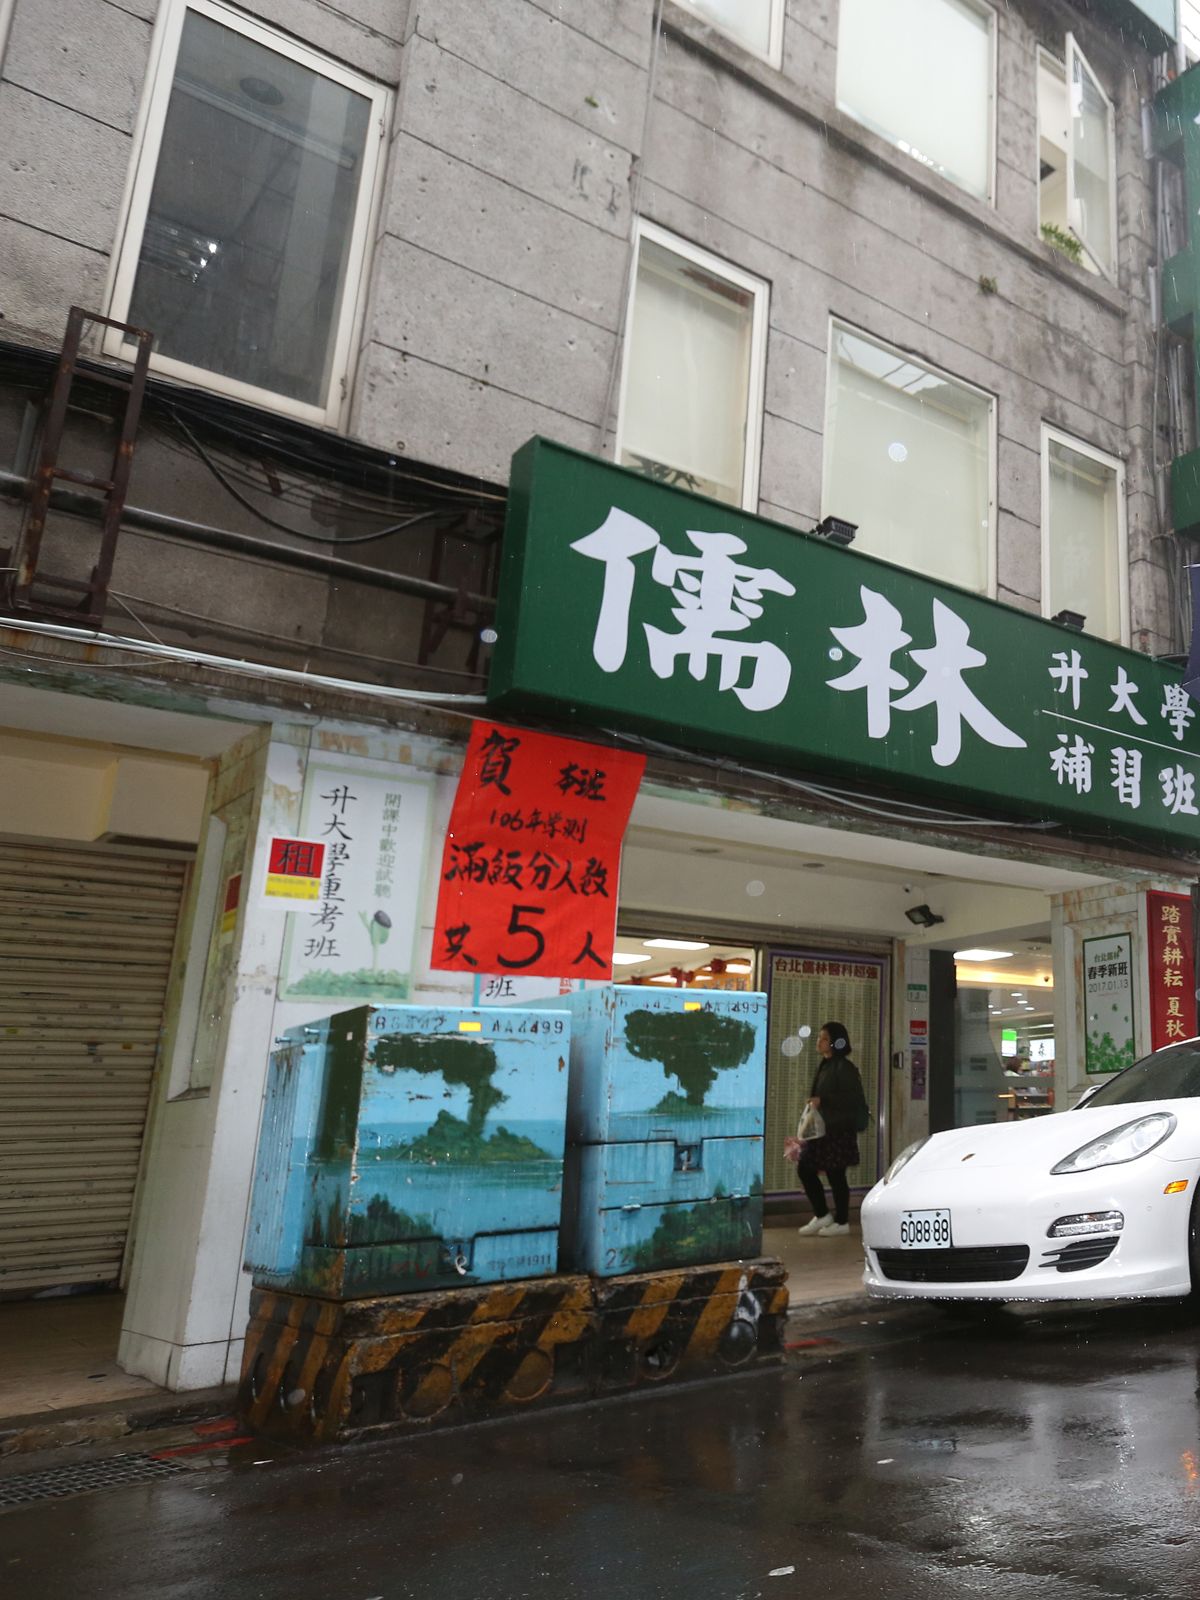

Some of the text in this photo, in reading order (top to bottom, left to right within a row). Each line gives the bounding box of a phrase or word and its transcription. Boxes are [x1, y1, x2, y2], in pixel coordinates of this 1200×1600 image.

[569, 505, 1028, 767] 儒林
[1048, 648, 1197, 742] 升大學
[478, 729, 522, 796] 賀
[1049, 732, 1200, 818] 補習班
[277, 842, 315, 877] 租
[304, 785, 358, 959] 升大學重考班
[1087, 961, 1128, 980] 春季新班
[1161, 905, 1184, 988] 踏實耕耘
[485, 976, 517, 998] 班
[1166, 996, 1187, 1045] 夏秋
